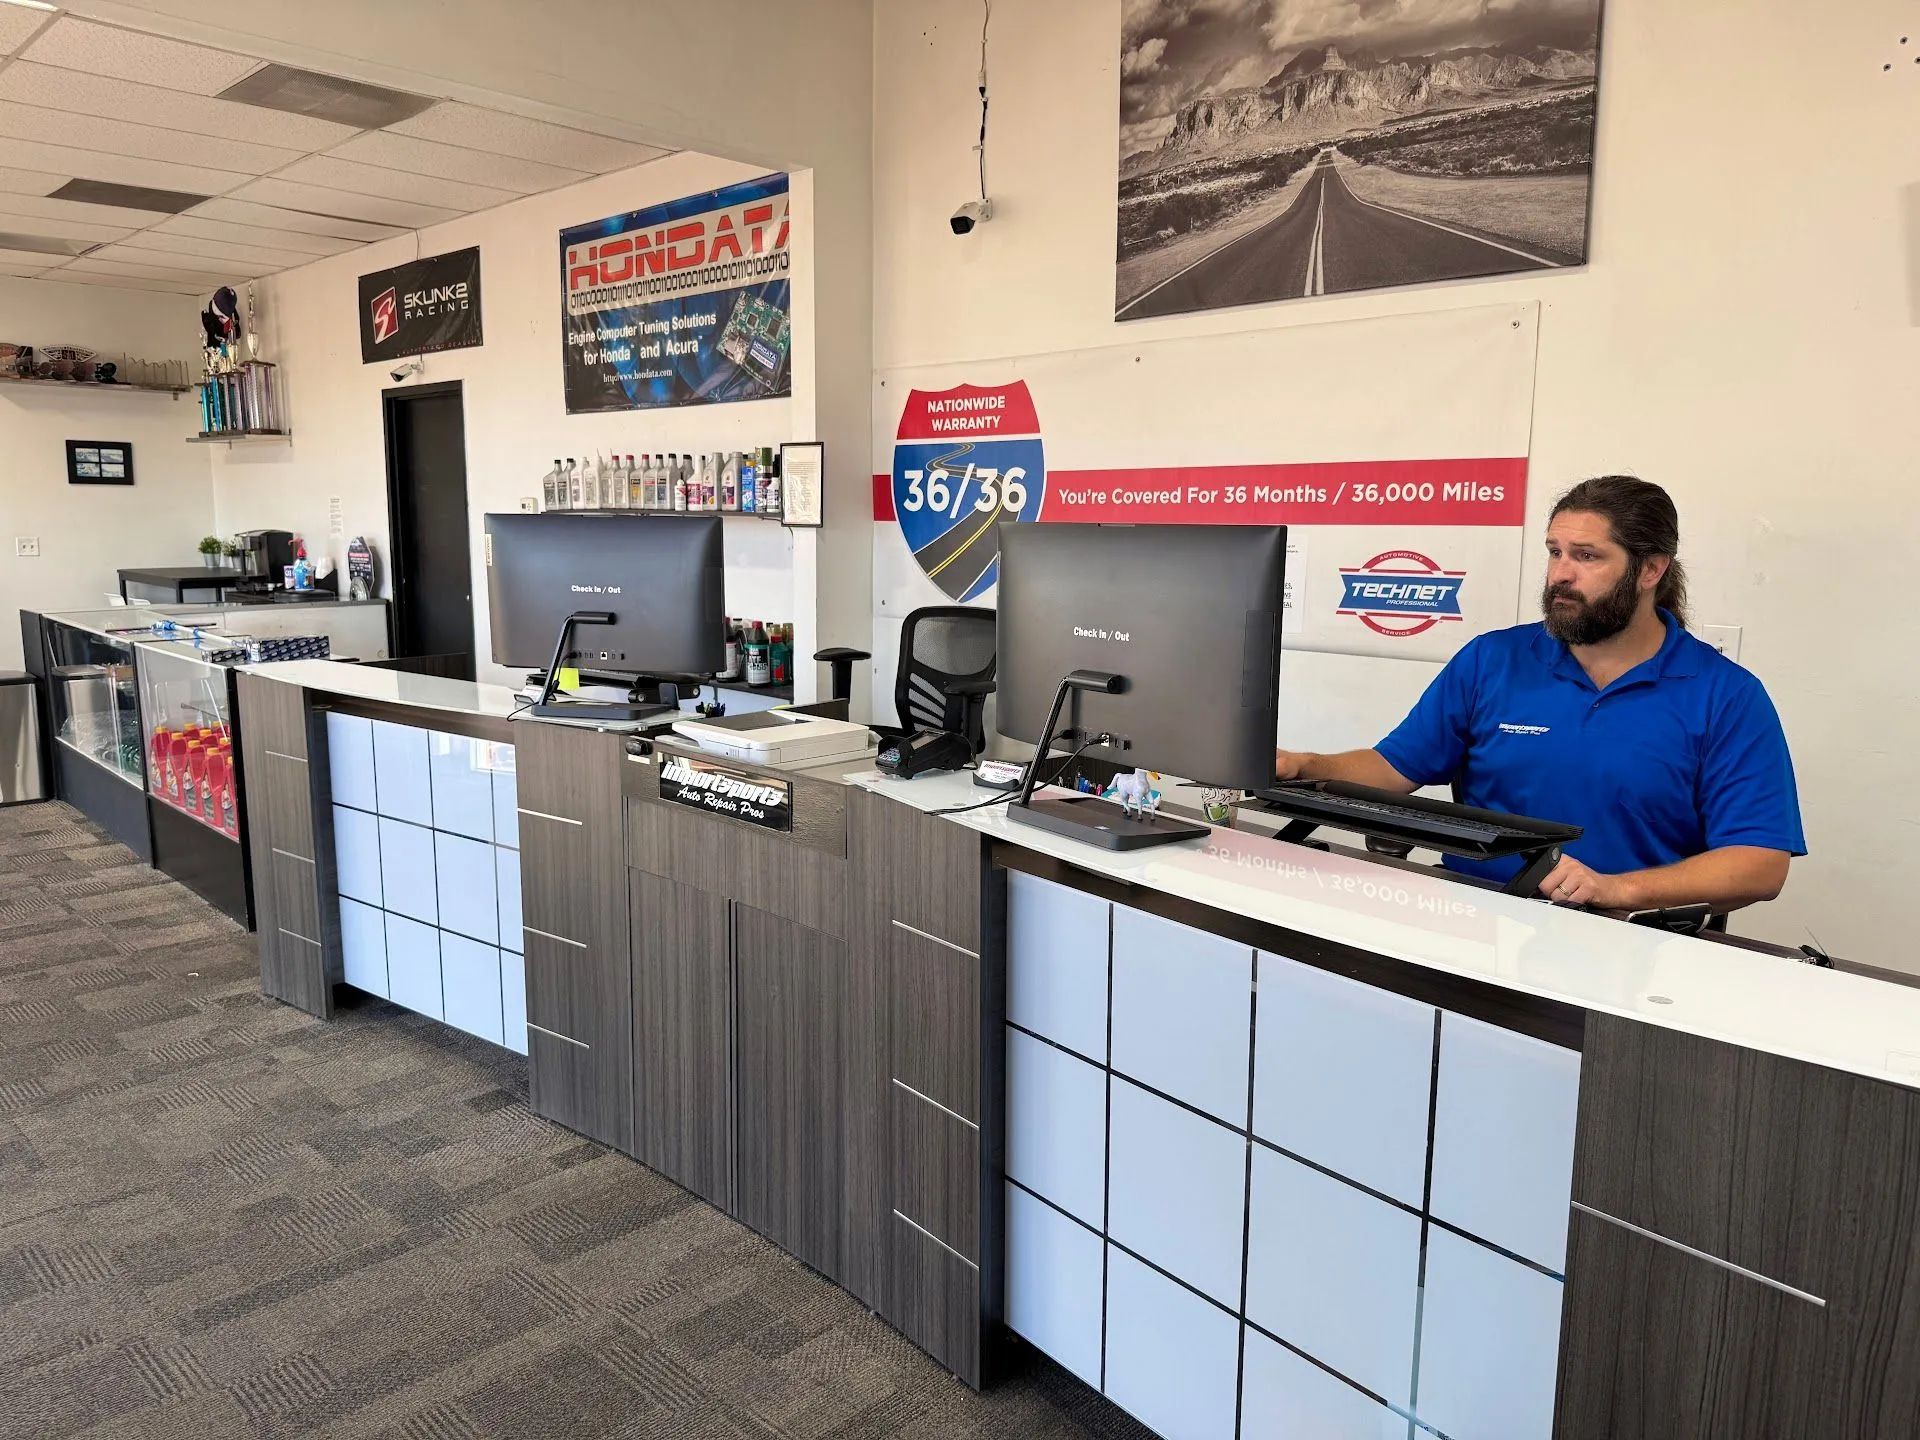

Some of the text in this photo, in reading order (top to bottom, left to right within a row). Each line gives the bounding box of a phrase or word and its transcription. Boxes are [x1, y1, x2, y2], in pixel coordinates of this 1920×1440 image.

[404, 282, 468, 309] SKUNK2
[405, 300, 469, 320] RACING
[569, 313, 717, 345] Engine Computer Tuning Solutions
[583, 350, 599, 366] for
[640, 342, 660, 358] and
[666, 339, 699, 355] Acura
[927, 396, 1006, 413] NATIONWIDE
[931, 416, 1001, 431] WARRANTY
[903, 463, 1027, 518] 36/36
[1059, 481, 1505, 506] You're Covered For 36 Months / 36,000 Miles
[1379, 551, 1424, 562] AUTOMOTIVE
[571, 585, 593, 593] Check
[608, 586, 621, 594] Out
[1385, 599, 1439, 607] PROFESSIONAL
[1073, 626, 1097, 638] Check
[1099, 629, 1107, 639] In
[1115, 630, 1130, 642] Out
[1381, 628, 1411, 636] SERVICE
[677, 786, 765, 819] Auto Repair Pros
